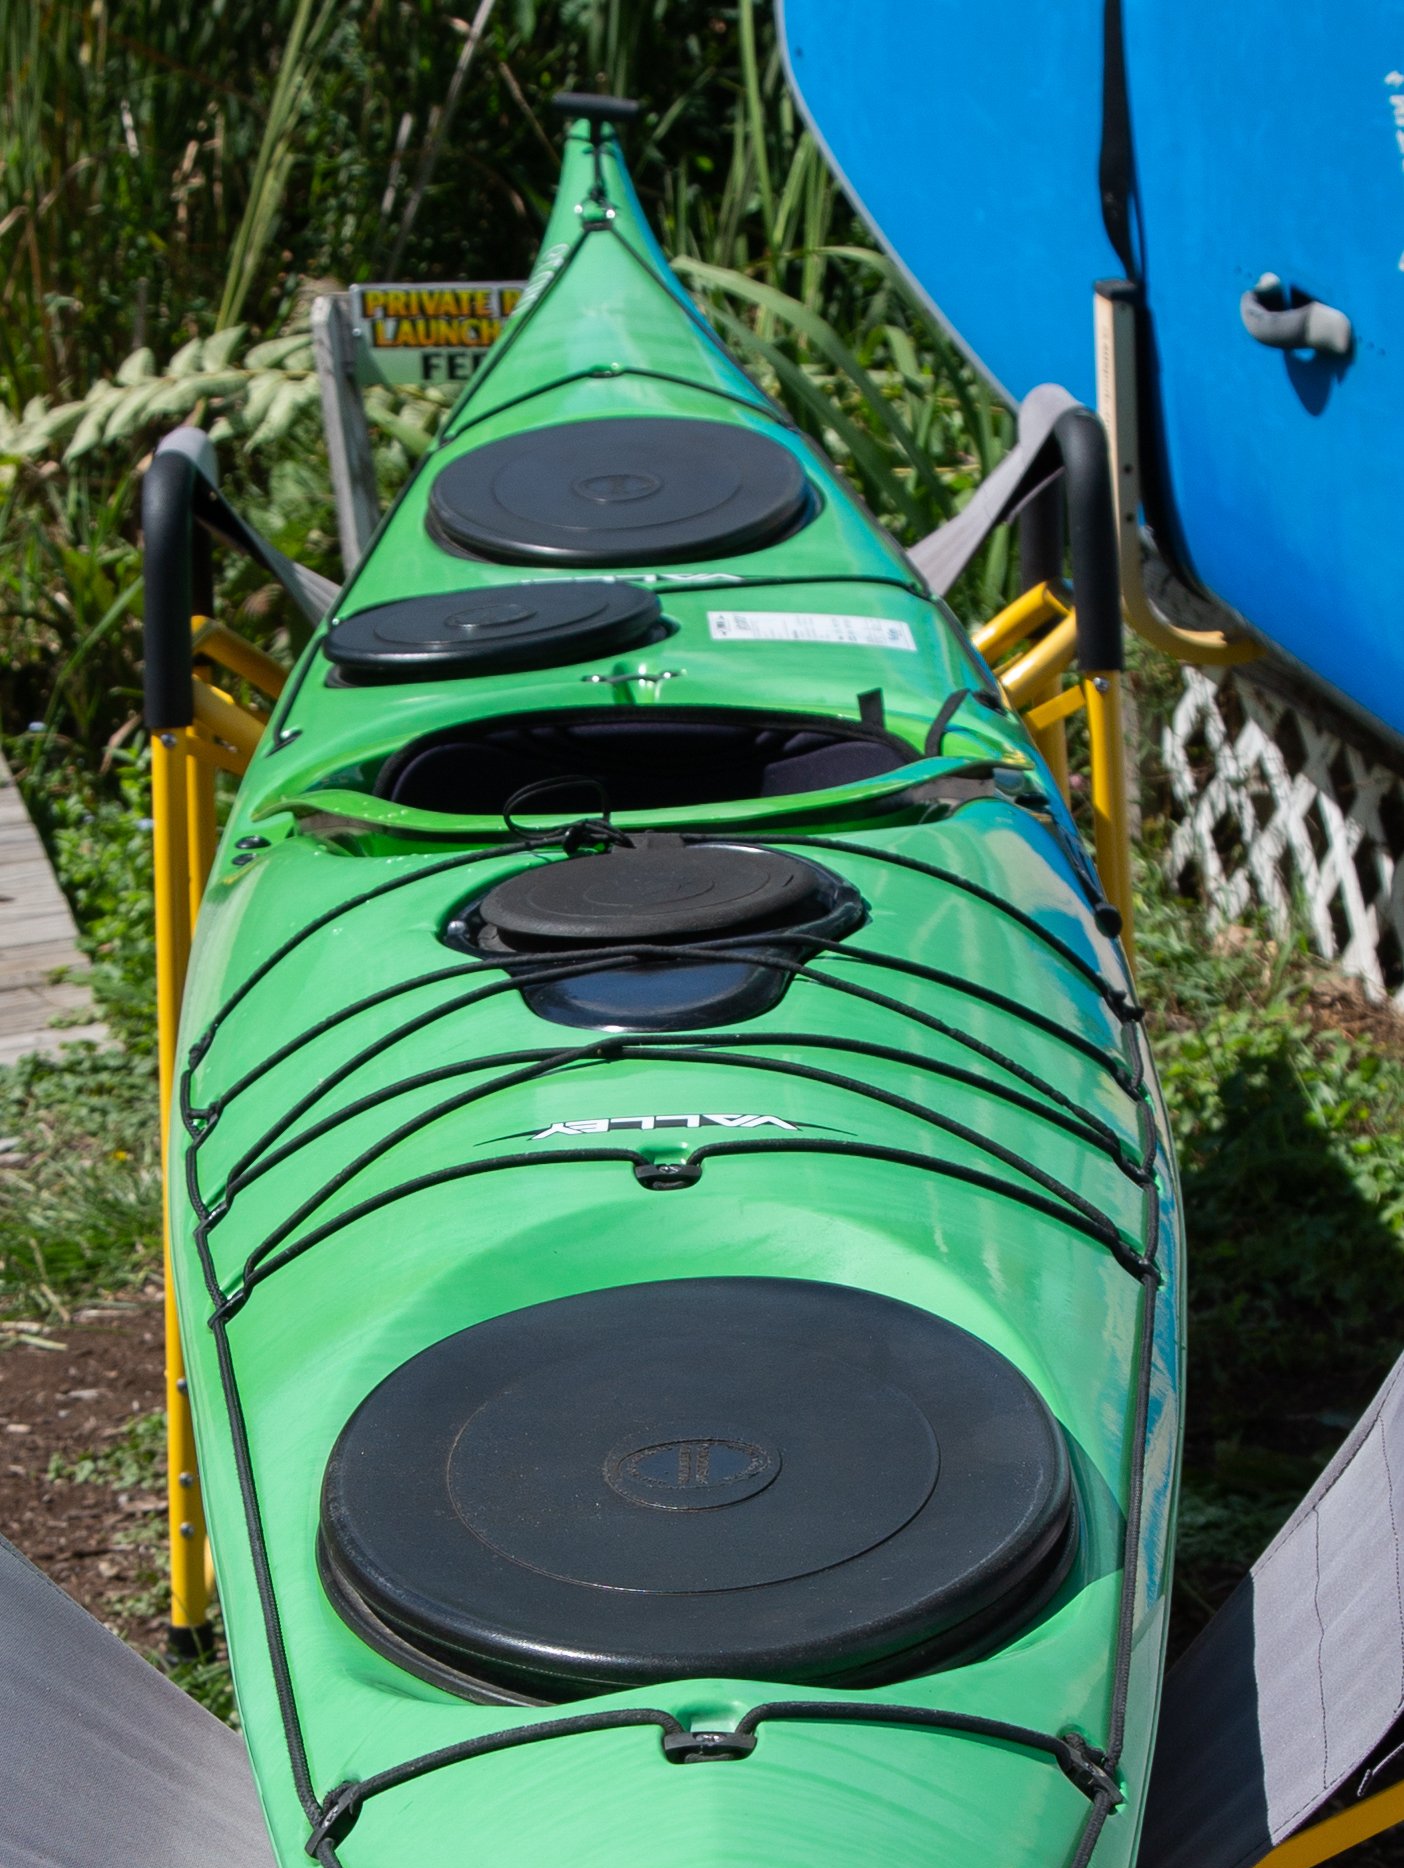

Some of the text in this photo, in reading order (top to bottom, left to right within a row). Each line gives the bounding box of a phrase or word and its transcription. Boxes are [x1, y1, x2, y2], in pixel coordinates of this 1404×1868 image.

[362, 287, 492, 318] PRIVATE
[371, 319, 501, 347] LAUNCH
[528, 1114, 800, 1140] VALLEY
